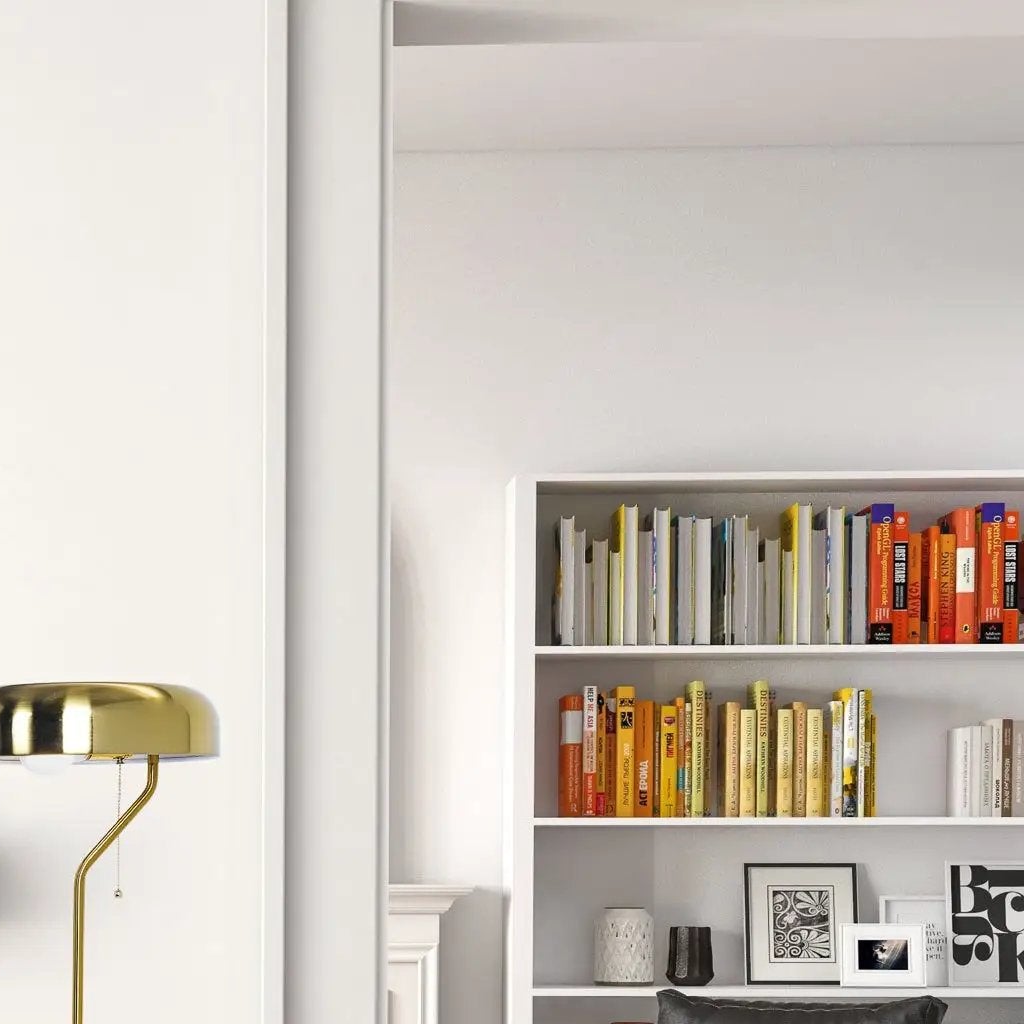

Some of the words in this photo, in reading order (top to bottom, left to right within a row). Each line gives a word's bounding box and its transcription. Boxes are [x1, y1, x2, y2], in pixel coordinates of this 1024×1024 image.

[880, 516, 892, 551] OpenGL
[991, 515, 1002, 550] OpenGL
[894, 545, 906, 561] LOST
[941, 552, 950, 577] KING
[991, 551, 1000, 588] Programming
[1005, 544, 1016, 560] LOST
[880, 552, 889, 588] Programming
[894, 562, 906, 583] STARS
[1004, 561, 1016, 583] STARS
[881, 589, 889, 606] Guide
[941, 581, 949, 627] STEPHEN
[992, 588, 1000, 605] Guide
[696, 690, 704, 737] DESTINIES
[759, 690, 768, 737] DESTINIES
[639, 760, 649, 807] АСТЕРОИД
